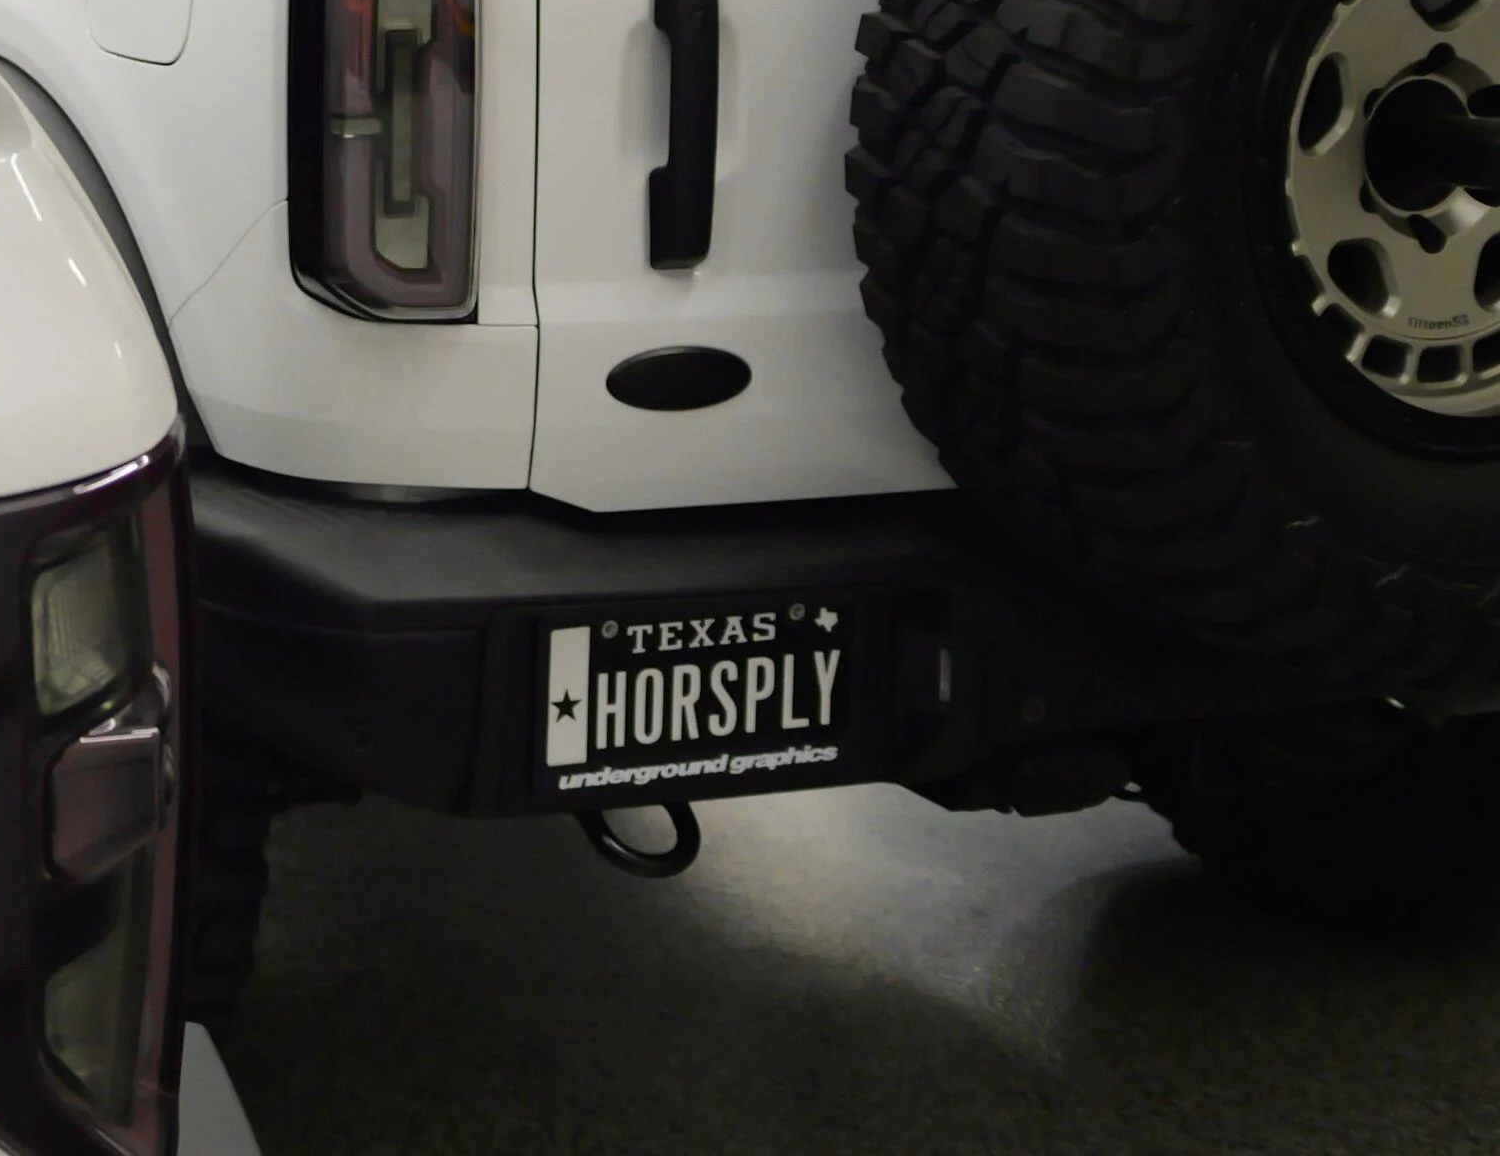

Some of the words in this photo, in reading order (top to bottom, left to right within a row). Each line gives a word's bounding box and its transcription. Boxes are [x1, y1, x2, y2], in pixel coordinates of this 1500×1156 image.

[627, 612, 777, 654] TEXAS
[595, 649, 842, 750] HORSPLY
[558, 753, 730, 790] underground
[729, 744, 839, 775] graphics
